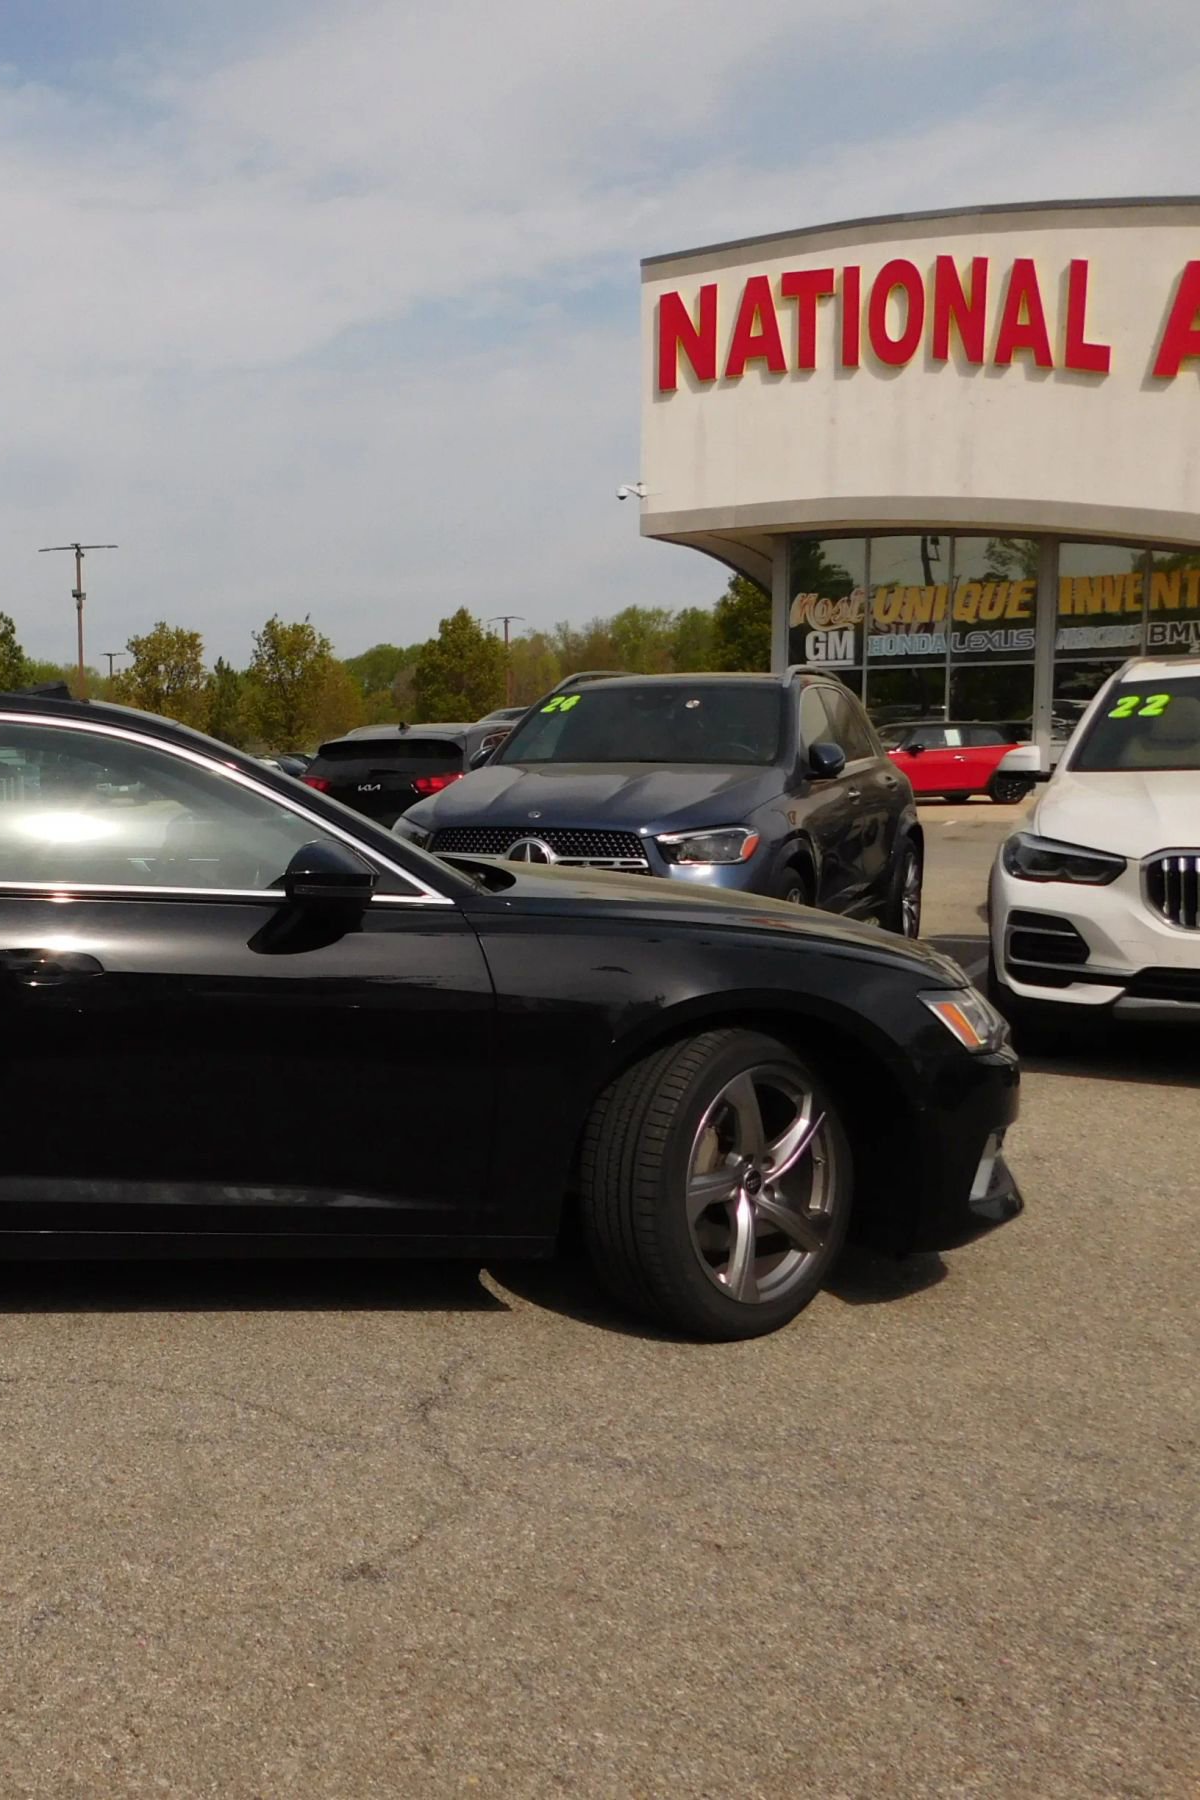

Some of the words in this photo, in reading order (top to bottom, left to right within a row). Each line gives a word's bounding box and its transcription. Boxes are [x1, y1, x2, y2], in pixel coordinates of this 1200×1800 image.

[658, 254, 1111, 392] NATIONAL
[873, 579, 1037, 624] UNIQUE
[805, 631, 854, 665] GM
[867, 633, 947, 656] HONDA
[951, 629, 1035, 653] LEXUS
[540, 695, 581, 713] 24
[1108, 694, 1170, 718] 22
[357, 783, 381, 792] KIA
